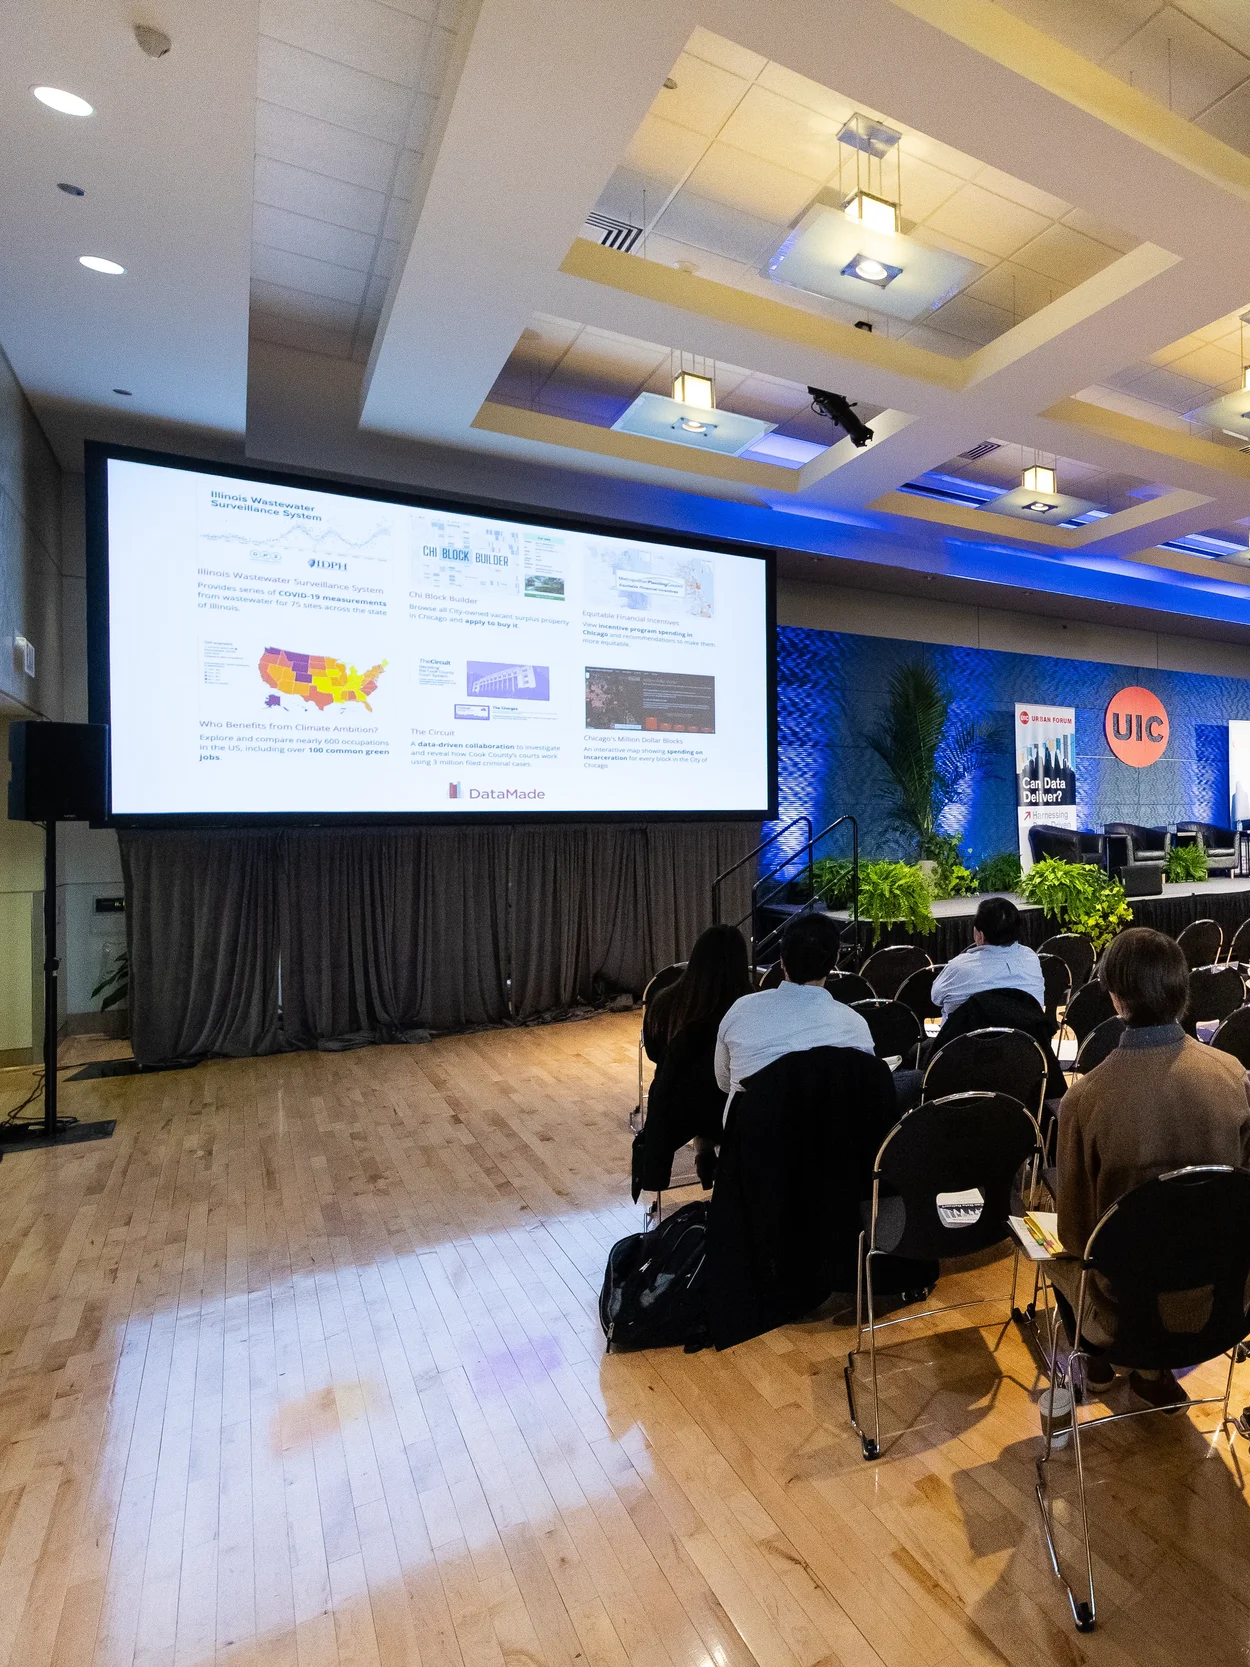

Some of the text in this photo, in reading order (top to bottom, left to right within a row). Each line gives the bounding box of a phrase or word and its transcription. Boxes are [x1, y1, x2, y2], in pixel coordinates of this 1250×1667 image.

[211, 491, 315, 512] Illinois Wastewater
[211, 500, 322, 522] Surveillance System
[423, 545, 438, 557] CHI
[442, 548, 470, 562] BLOCK
[475, 552, 508, 566] BUILDER
[316, 560, 348, 571] IDPH
[198, 568, 384, 595] Illinois Wastewater Surveillance System
[198, 582, 236, 592] Provides
[239, 586, 265, 596] series
[279, 590, 320, 600] COVID-19
[323, 596, 387, 607] measurements
[425, 593, 447, 601] Block
[450, 596, 478, 604] Builder
[198, 592, 220, 600] from
[222, 596, 273, 606] wastewater
[303, 602, 322, 610] sites
[209, 603, 240, 612] Illinois.
[409, 604, 436, 612] Browse
[449, 607, 488, 618] City-owned
[491, 612, 513, 620] vacant
[515, 614, 539, 623] surplus
[541, 617, 570, 626] property
[418, 614, 447, 623] Chicago
[465, 618, 485, 626] apply
[582, 610, 679, 626] Equitable Financial Incentives
[623, 633, 675, 644] recommendations
[658, 630, 685, 638] spending
[601, 639, 630, 648] equitable.
[199, 720, 378, 734] Who Benefits from Climate Ambition?
[1112, 712, 1164, 742] UIC
[200, 734, 234, 743] Explore
[256, 736, 293, 746] compare
[296, 737, 322, 746] nearly
[584, 735, 616, 743] Chicago's
[245, 745, 284, 754] including
[1023, 777, 1066, 789] Can Data
[469, 789, 545, 799] DataMade
[1023, 791, 1062, 803] Deliver?
[1032, 811, 1068, 820] Harnessing
